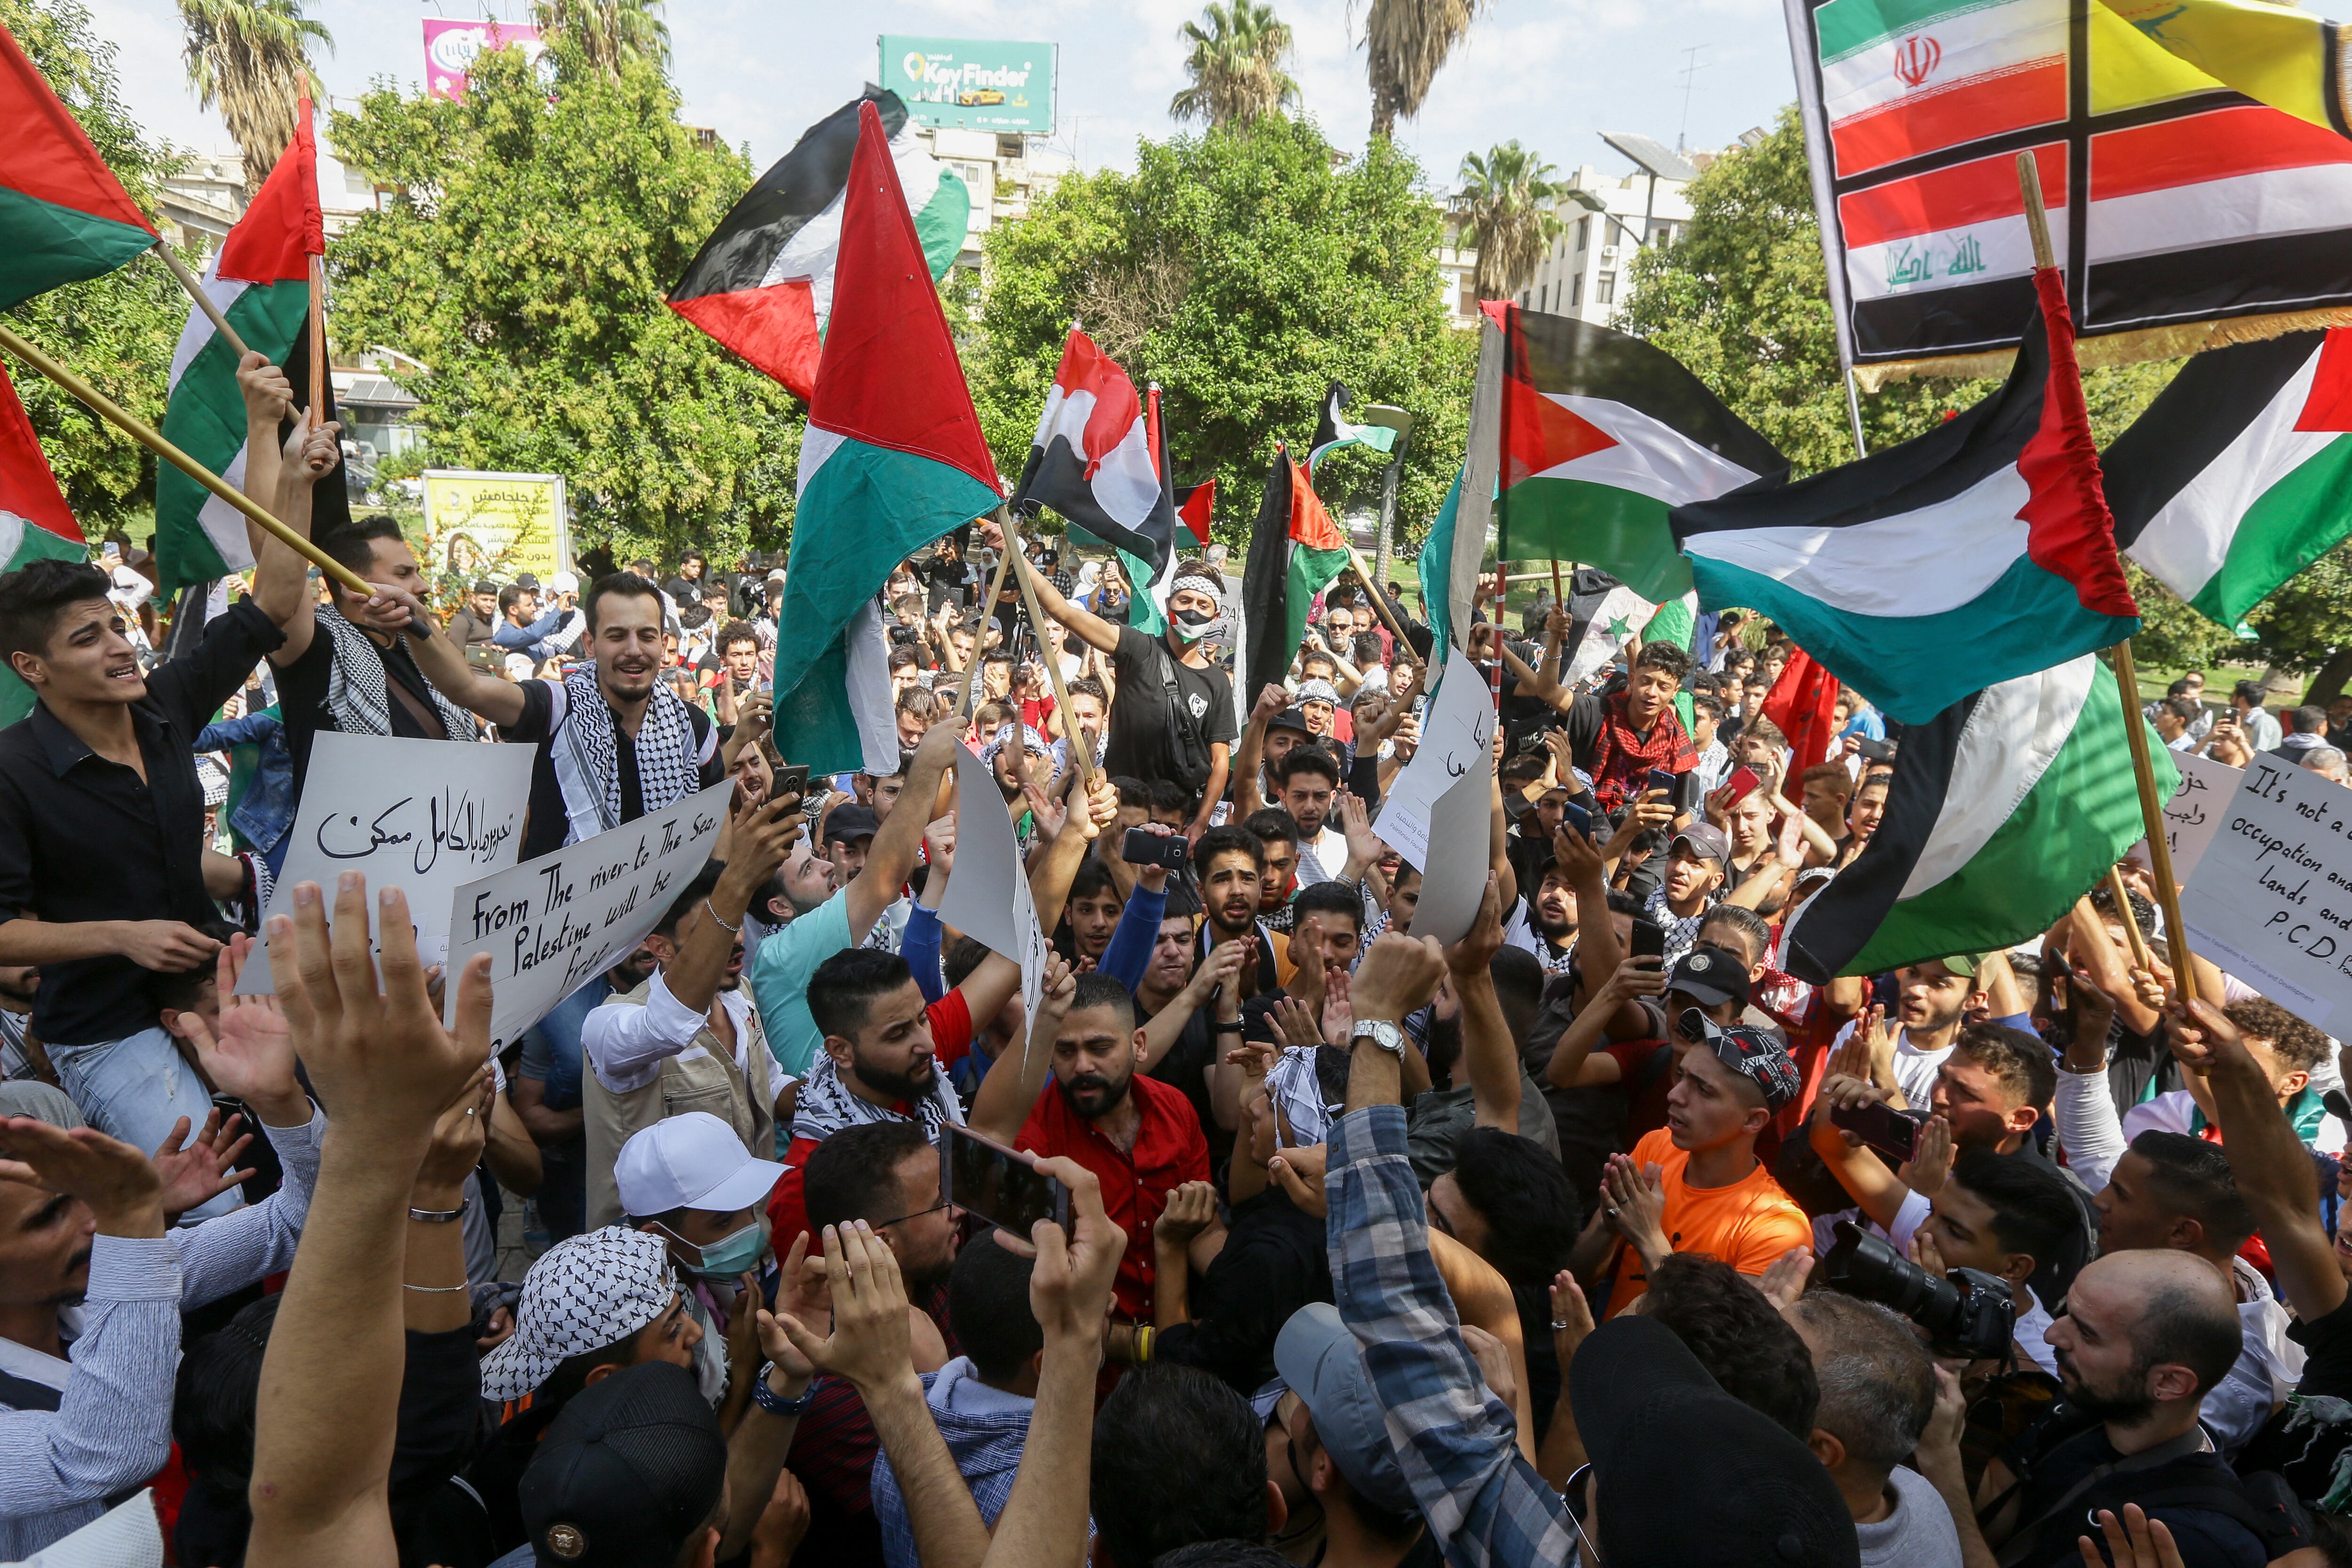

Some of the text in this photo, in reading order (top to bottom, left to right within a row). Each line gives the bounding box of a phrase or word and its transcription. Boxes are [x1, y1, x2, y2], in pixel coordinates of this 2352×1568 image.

[526, 553, 551, 562] بدون
[1518, 731, 1540, 749] NIKE
[317, 797, 413, 859] ممكن
[414, 784, 478, 875] بالكامل
[1396, 812, 1417, 834] والتنمية
[2245, 764, 2344, 833] It's not a
[1389, 822, 1411, 843] Palestinian
[539, 861, 574, 916] The
[589, 862, 628, 893] river
[633, 834, 650, 872] to
[659, 819, 682, 859] The
[513, 869, 671, 978] Palestine will be
[2211, 938, 2241, 959] Foundation
[2249, 960, 2267, 976] Culture
[2267, 972, 2278, 982] and
[2278, 979, 2315, 1004] Development
